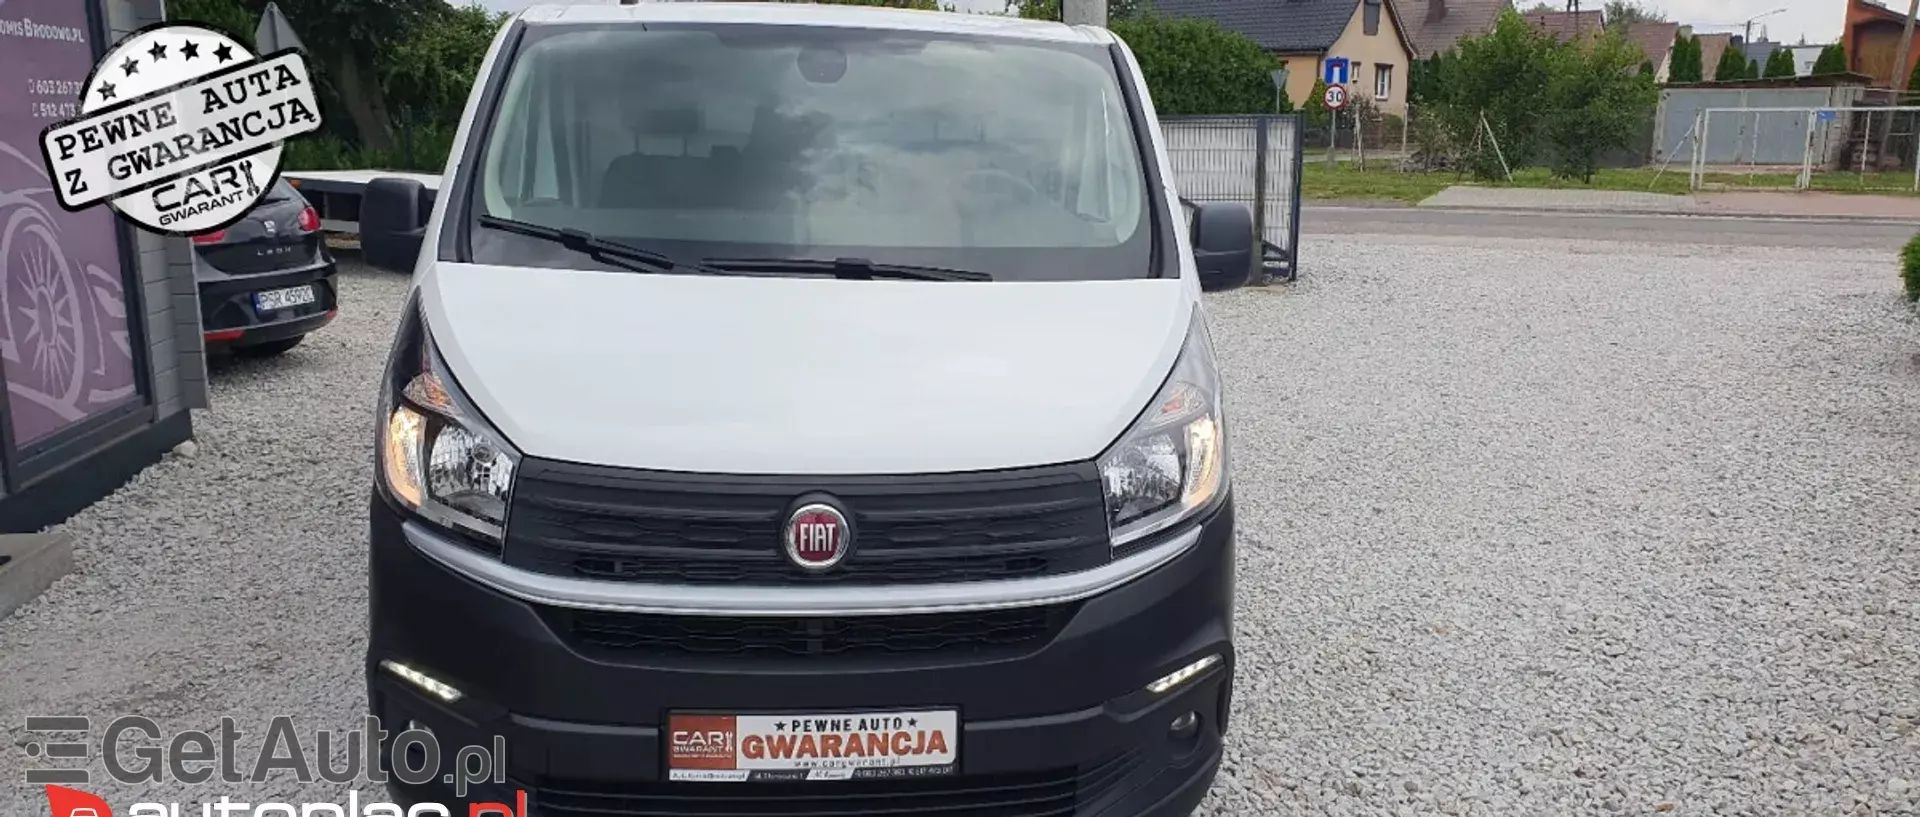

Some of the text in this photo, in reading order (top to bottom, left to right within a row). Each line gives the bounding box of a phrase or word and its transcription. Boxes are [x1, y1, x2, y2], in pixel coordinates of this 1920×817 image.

[1327, 91, 1344, 102] 30
[800, 523, 836, 552] FIAT
[792, 717, 902, 732] PEWNE AUTO
[673, 731, 724, 745] CAR
[741, 730, 948, 760] GWARANCJA
